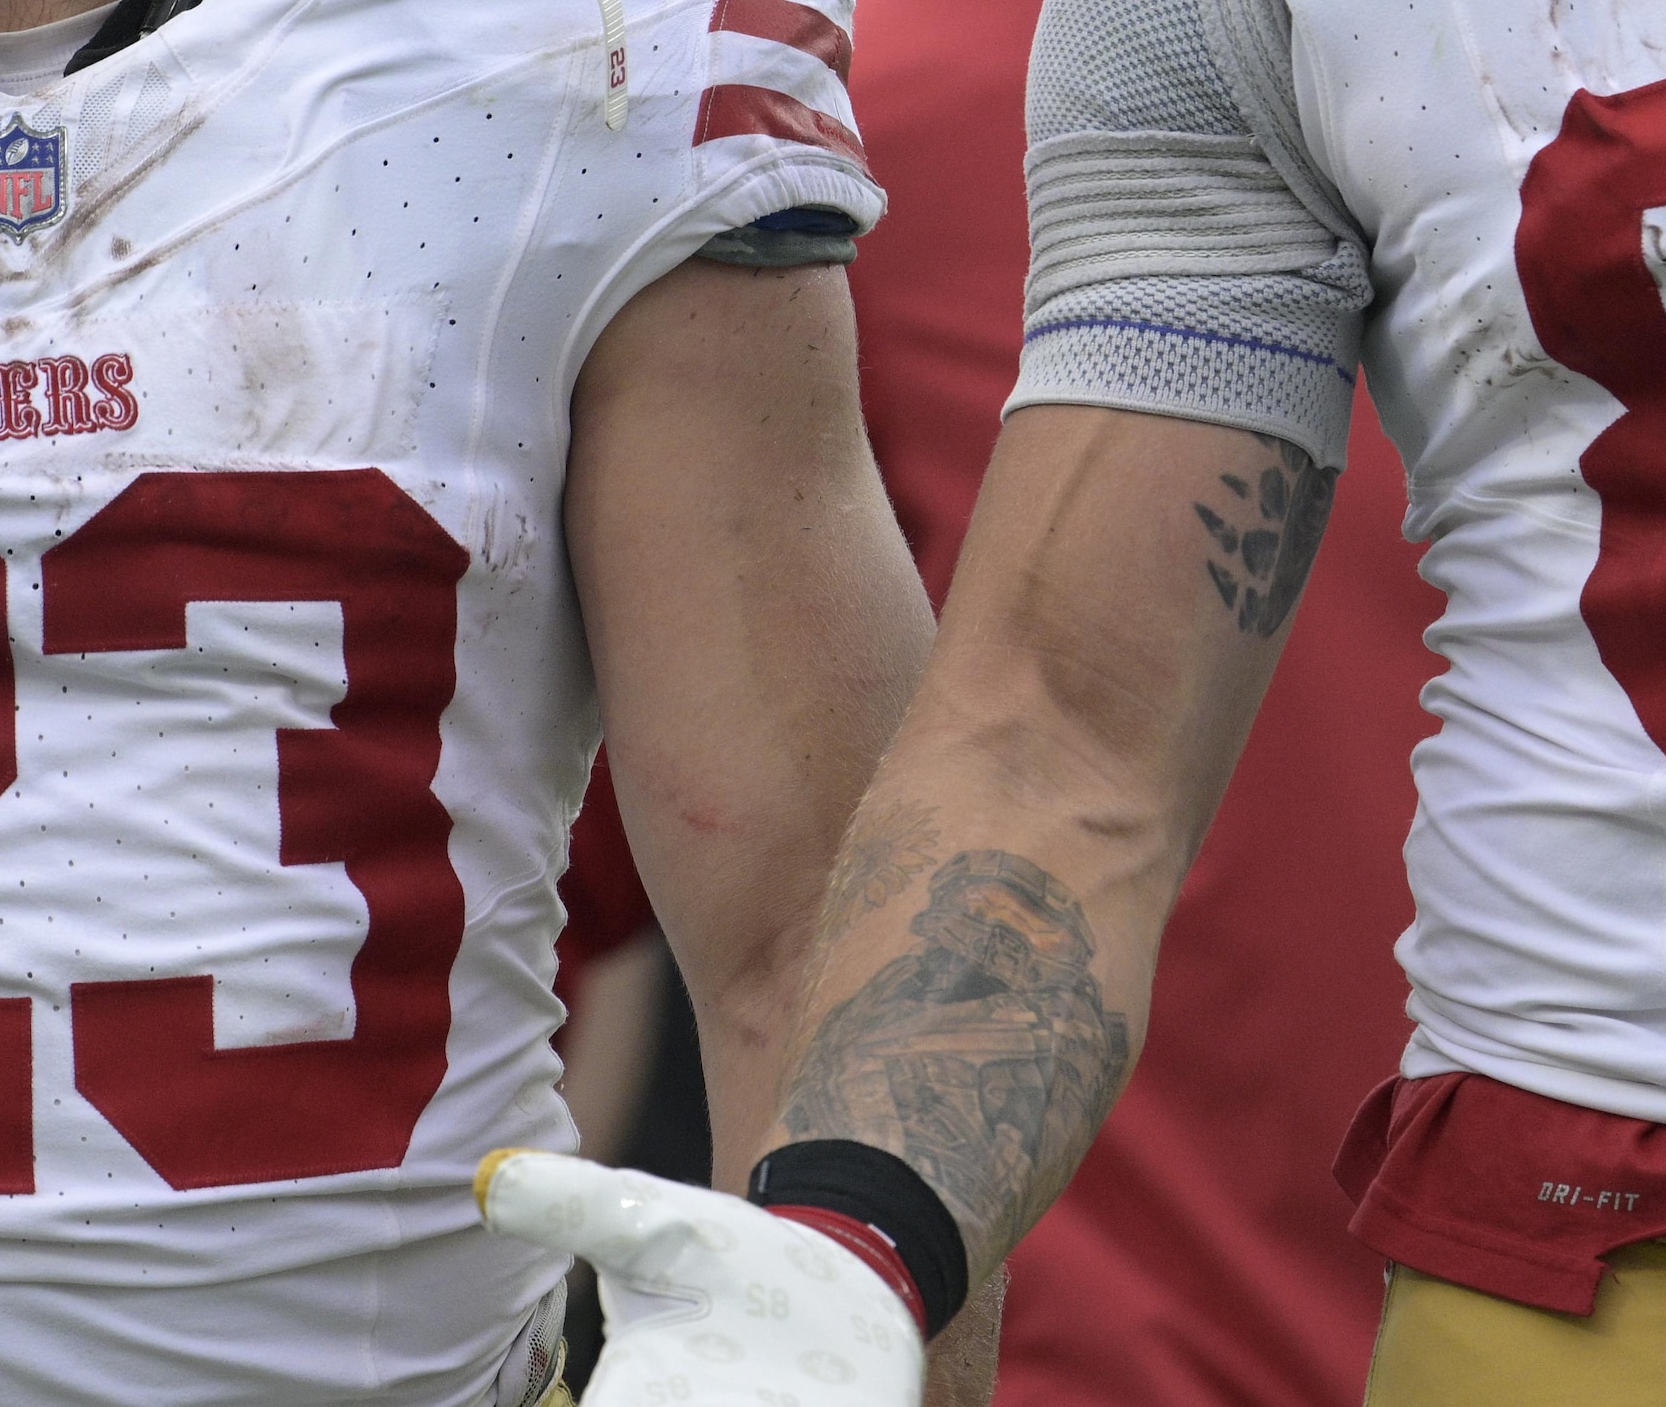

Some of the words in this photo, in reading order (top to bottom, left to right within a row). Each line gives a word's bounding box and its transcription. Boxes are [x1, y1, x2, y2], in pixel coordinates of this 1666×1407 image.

[609, 46, 626, 89] 23
[1536, 1181, 1641, 1212] DRI-FIT
[743, 1281, 791, 1321] 85
